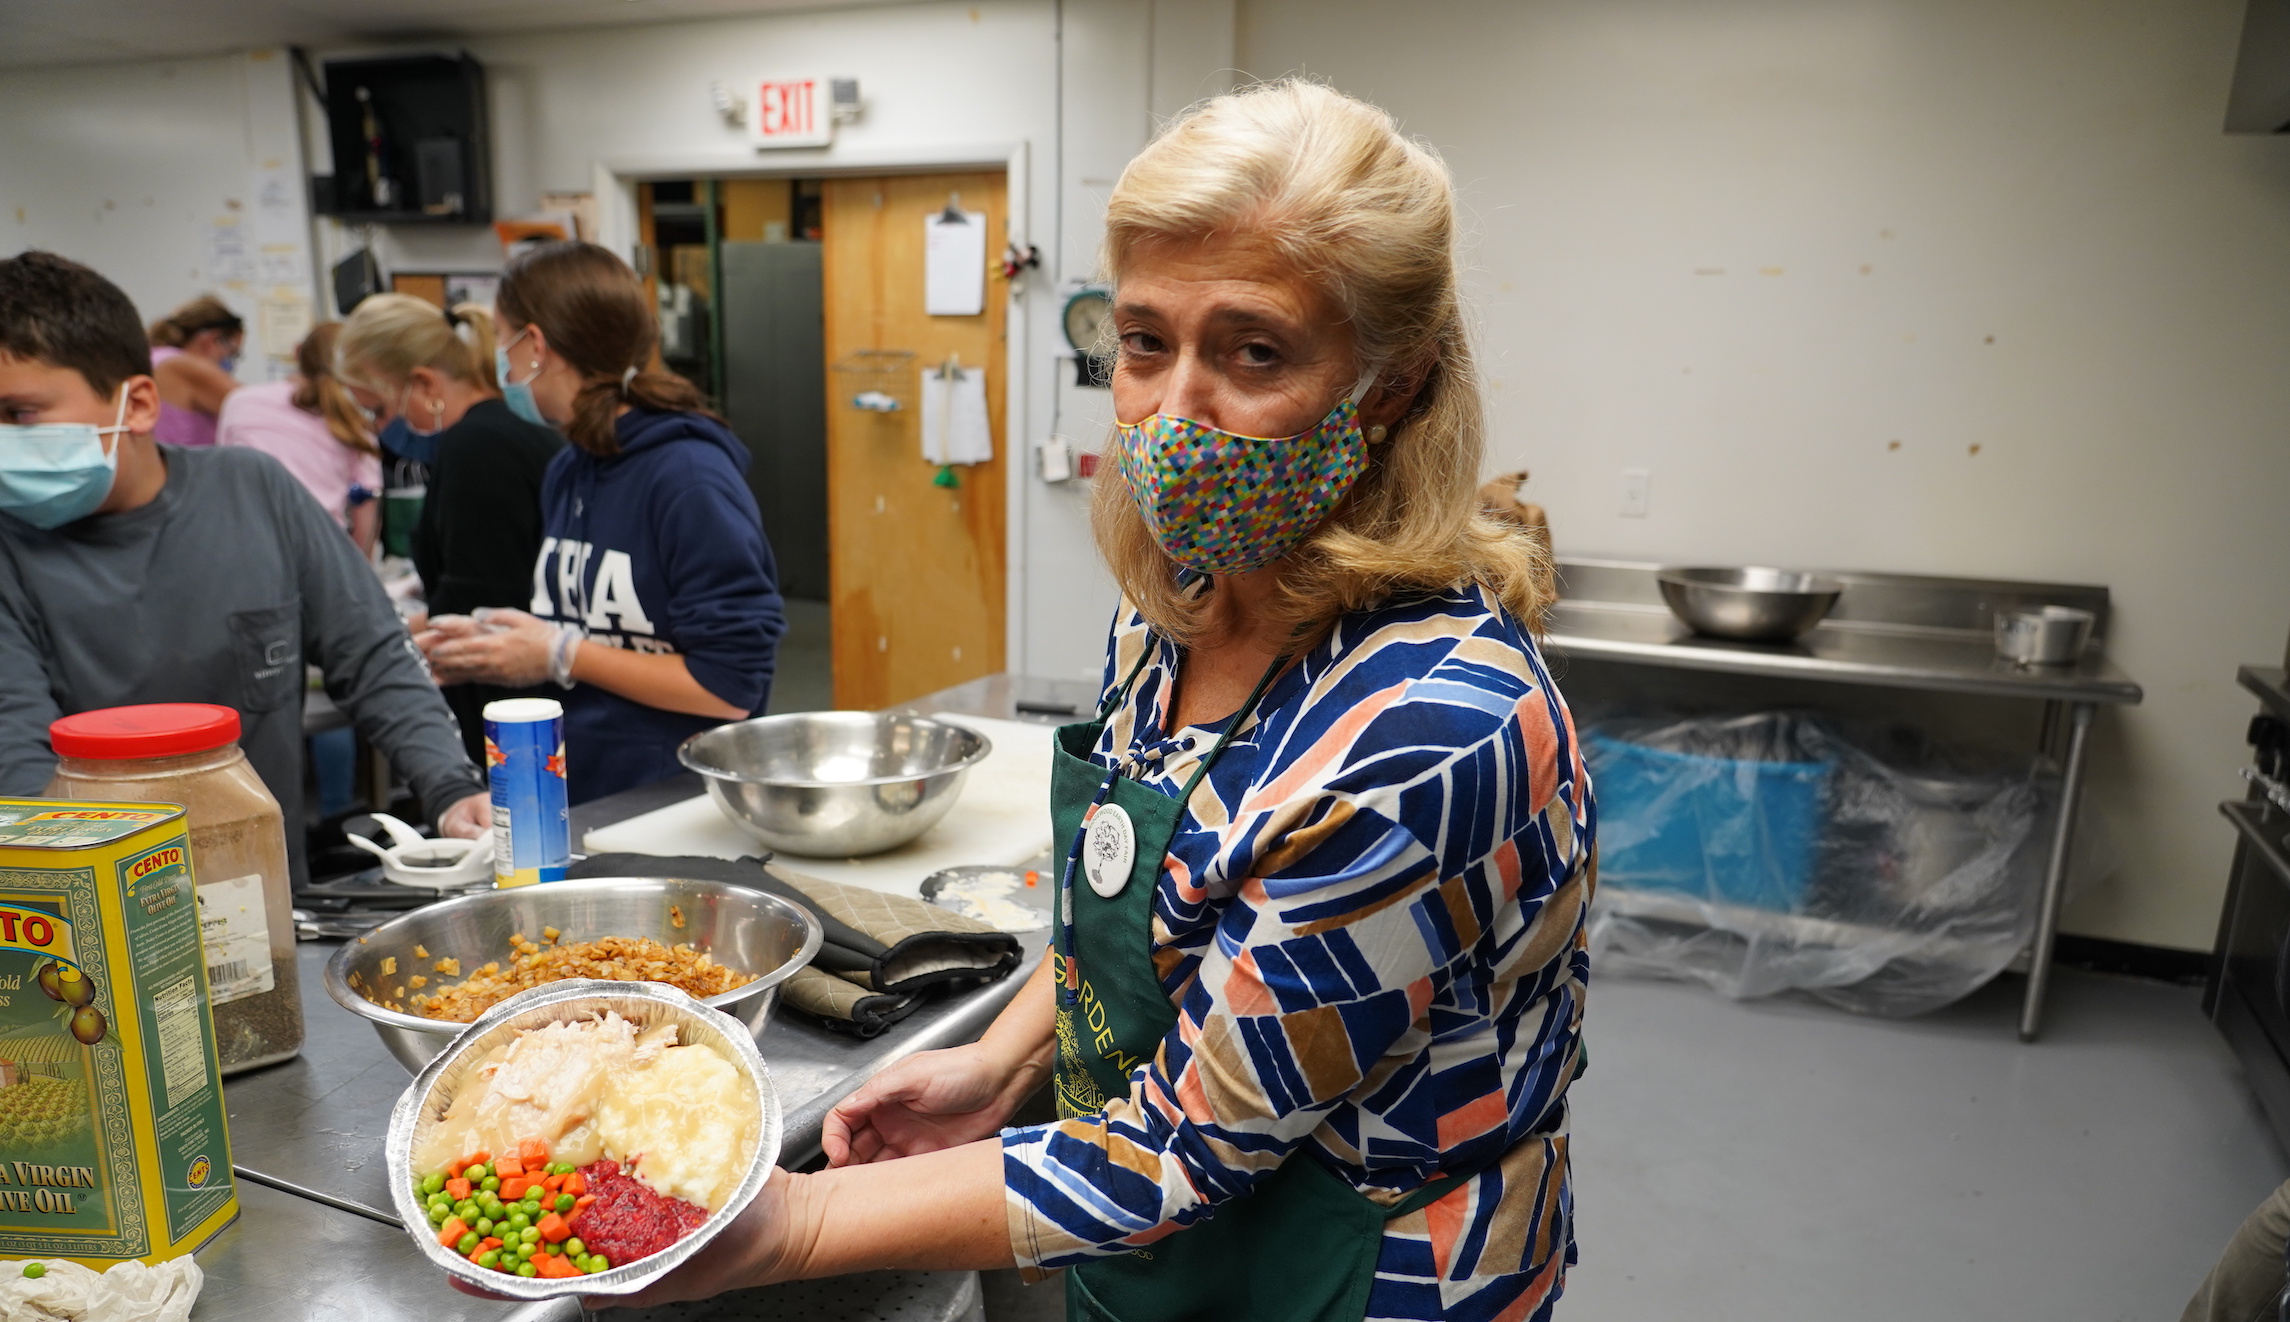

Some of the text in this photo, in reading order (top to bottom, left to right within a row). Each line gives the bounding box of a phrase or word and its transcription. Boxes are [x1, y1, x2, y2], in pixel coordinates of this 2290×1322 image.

[760, 79, 815, 136] EXIT
[51, 811, 154, 821] CENTO
[1113, 810, 1125, 829] EARTH
[133, 848, 179, 877] CENTO
[140, 882, 181, 909] EXTRA VIRGIN
[154, 985, 178, 1002] Nutrition
[179, 977, 192, 989] Facts
[11, 1161, 94, 1188] VIRGIN
[189, 1163, 210, 1183] CENTO
[34, 1188, 77, 1214] OIL
[73, 1243, 98, 1251] LITERS
